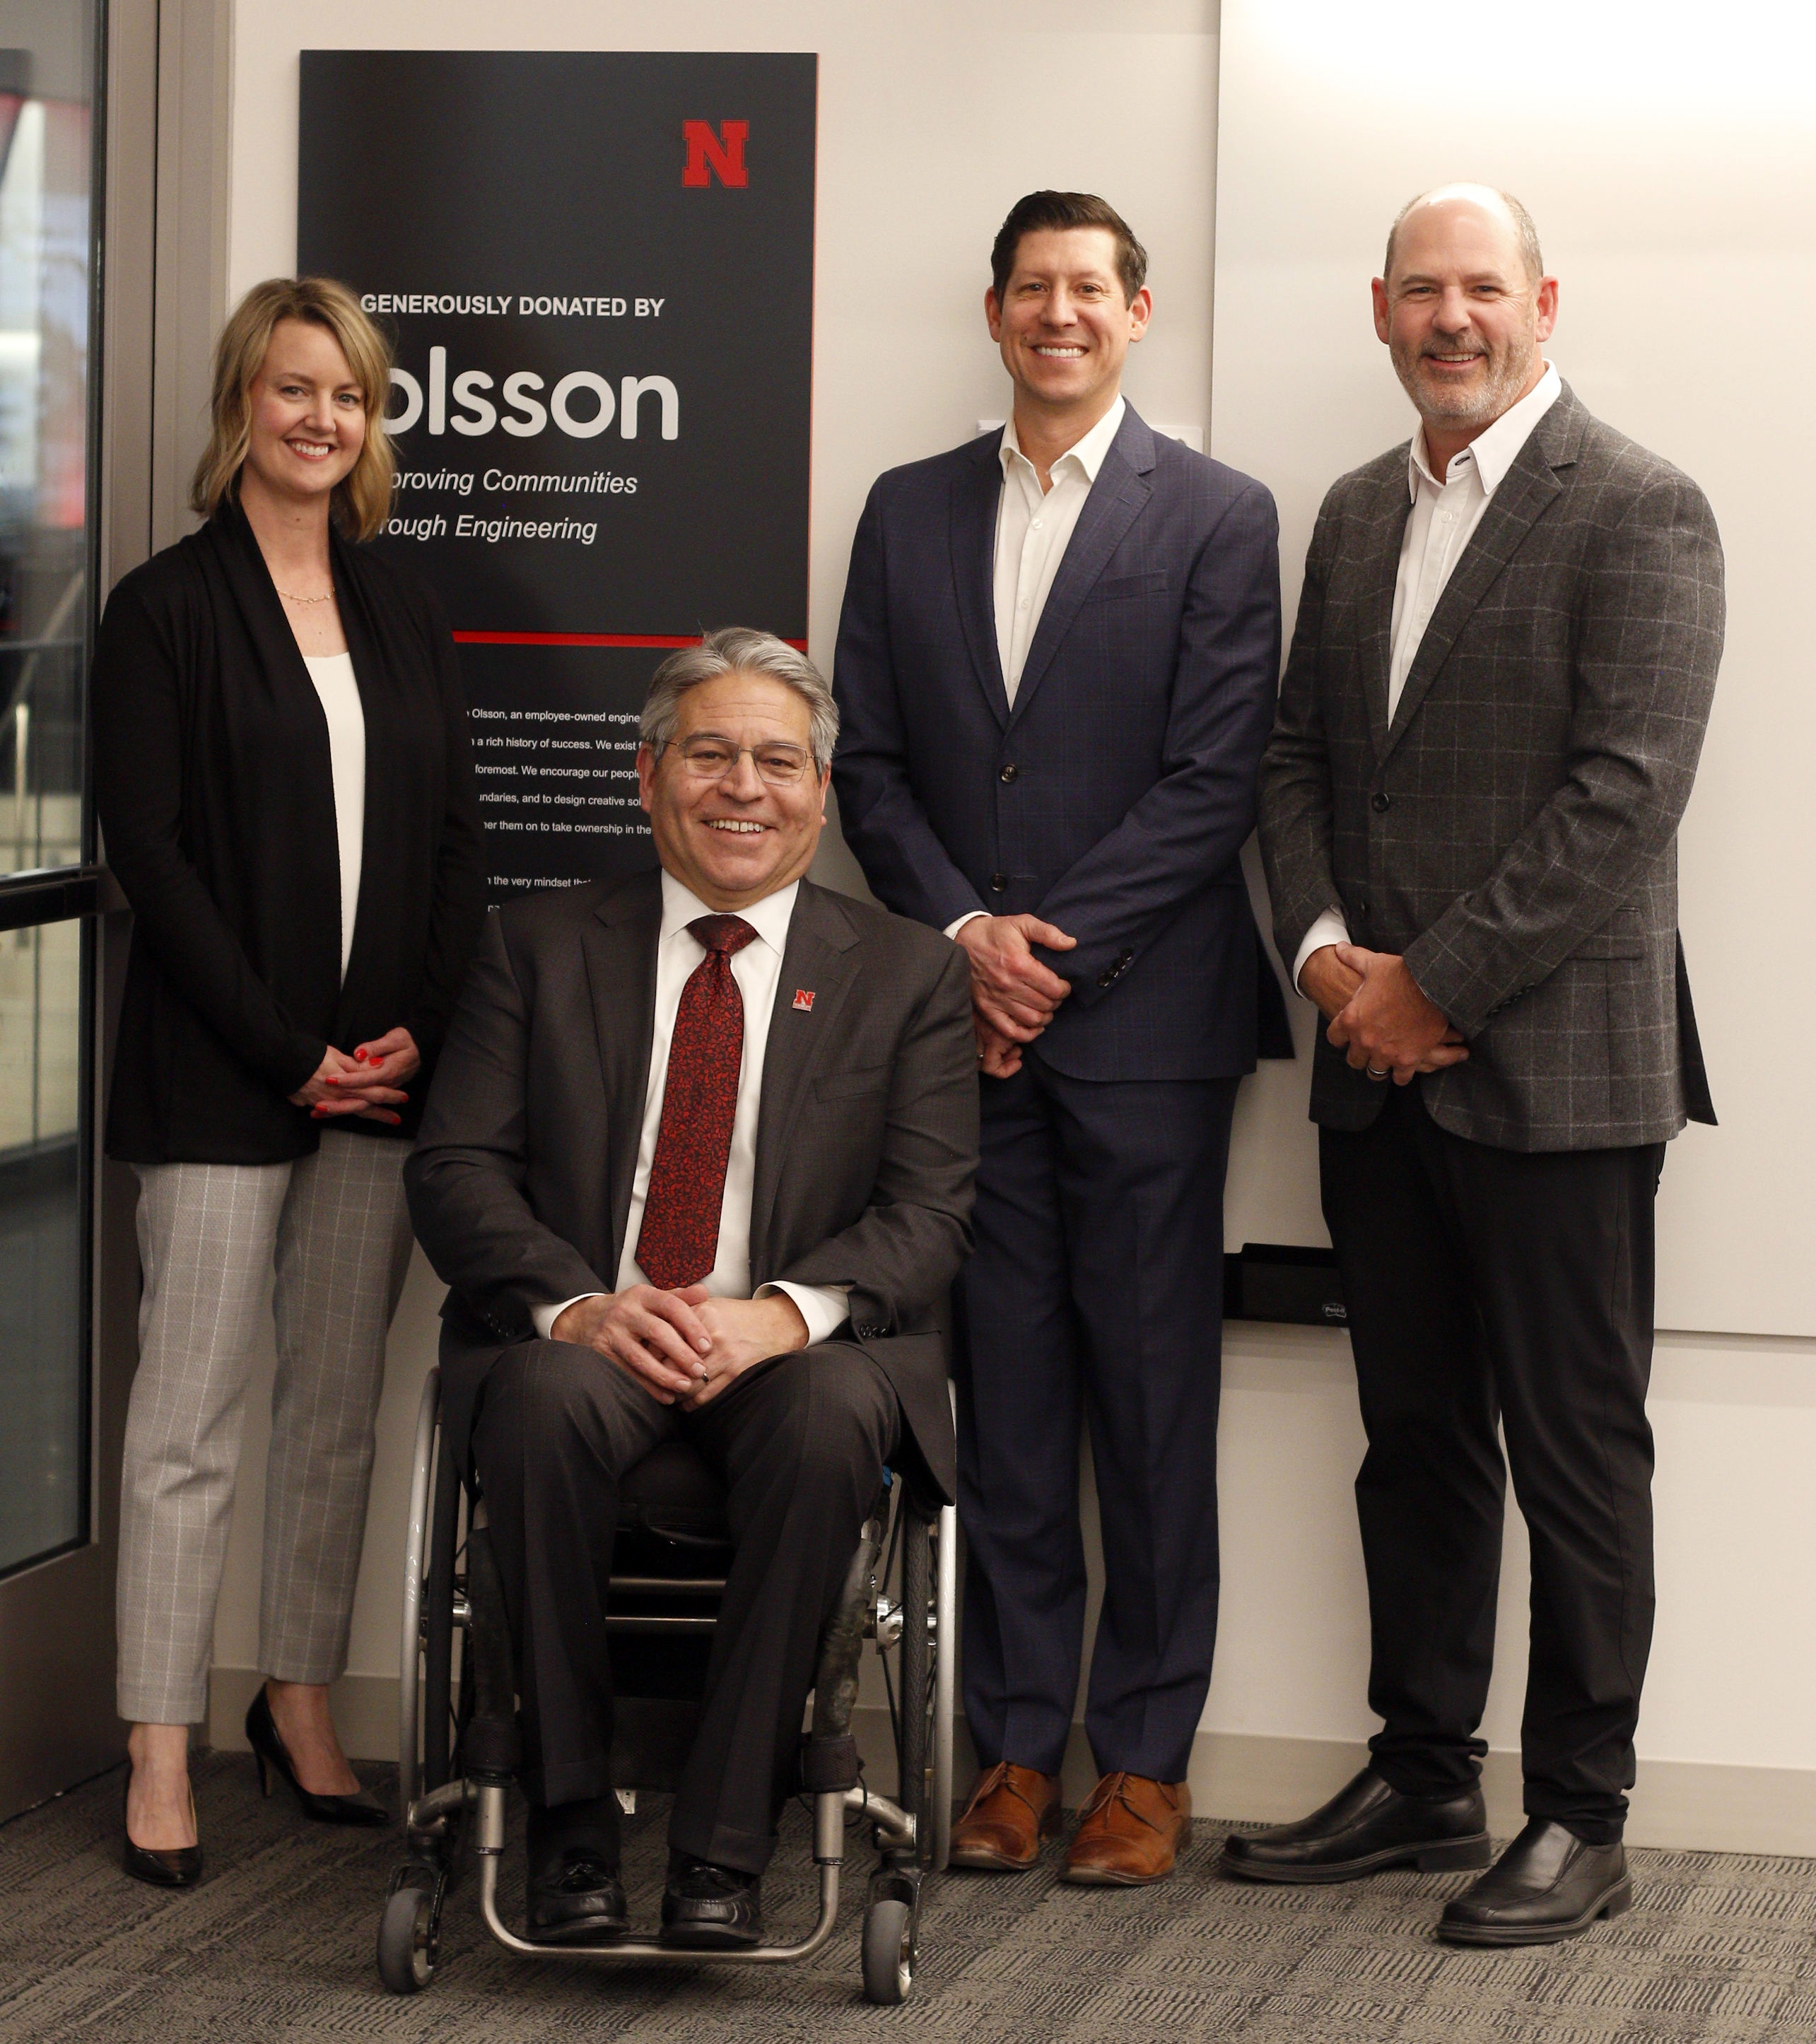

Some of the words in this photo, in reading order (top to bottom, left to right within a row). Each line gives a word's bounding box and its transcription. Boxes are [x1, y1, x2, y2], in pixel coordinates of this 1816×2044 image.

[682, 119, 749, 189] N
[359, 293, 512, 316] GENEROUSLY
[520, 297, 626, 316] DONATED
[635, 298, 665, 317] BY
[382, 346, 679, 440] olsson
[484, 469, 638, 493] Communities
[455, 515, 597, 545] Engineering
[472, 709, 507, 719] Olsson,
[525, 711, 605, 722] employee-owned
[486, 737, 503, 746] rich
[506, 737, 537, 749] history
[540, 739, 549, 748] of
[596, 740, 611, 750] We
[614, 741, 635, 750] exist
[476, 764, 518, 775] foremost.
[521, 765, 537, 775] We
[540, 768, 590, 779] encourage
[522, 794, 539, 803] and
[543, 794, 551, 803] to
[554, 794, 585, 806] design
[588, 797, 625, 806] creative
[500, 821, 522, 830] them
[541, 822, 549, 831] to
[552, 823, 572, 832] take
[575, 824, 623, 835] ownership
[626, 825, 633, 833] in
[637, 825, 652, 835] the
[494, 876, 508, 885] the
[511, 879, 532, 888] very
[534, 877, 571, 887] mindset
[793, 989, 816, 1007] N
